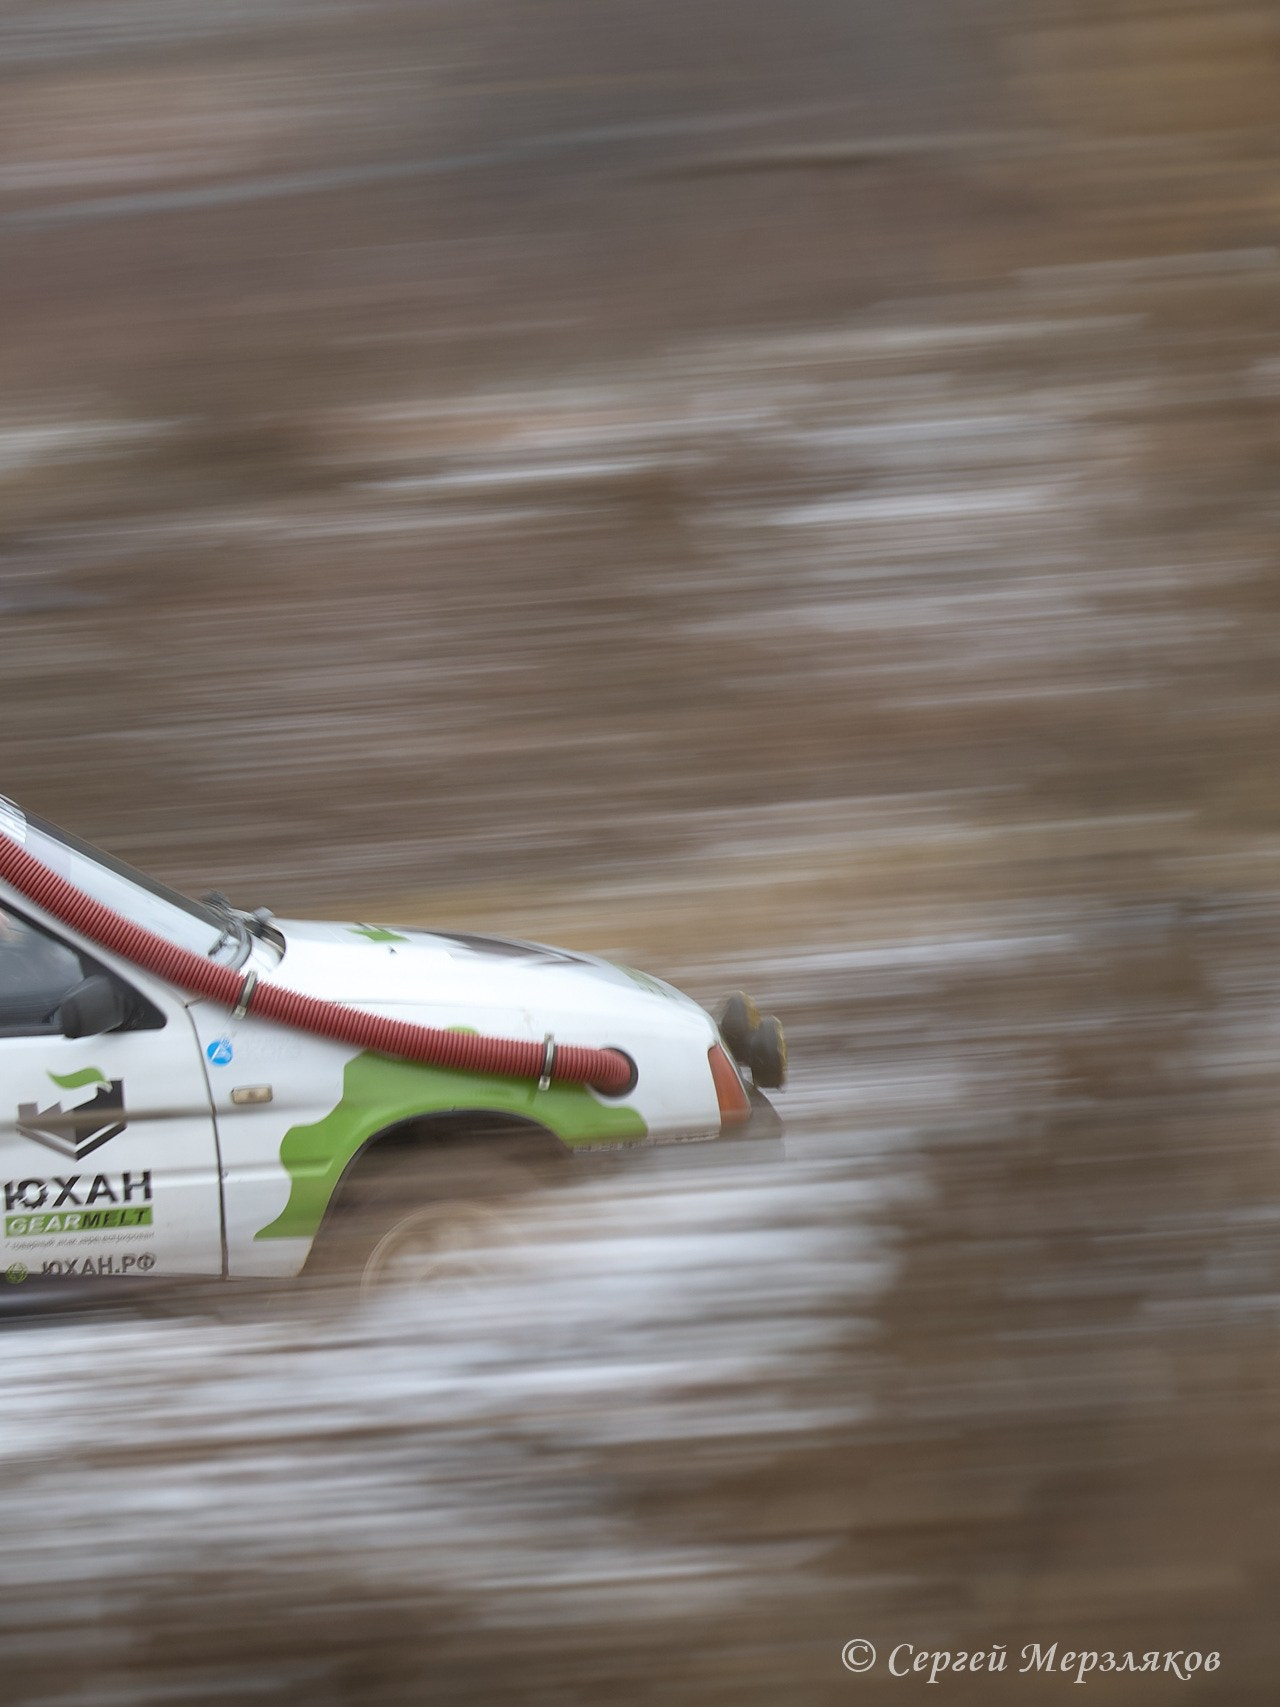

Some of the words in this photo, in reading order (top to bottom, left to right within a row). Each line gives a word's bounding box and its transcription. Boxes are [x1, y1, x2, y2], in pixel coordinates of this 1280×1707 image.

[4, 1168, 153, 1212] ЮХАН
[8, 1209, 146, 1235] GEARMELT
[41, 1252, 157, 1276] ЮХАН.РФ
